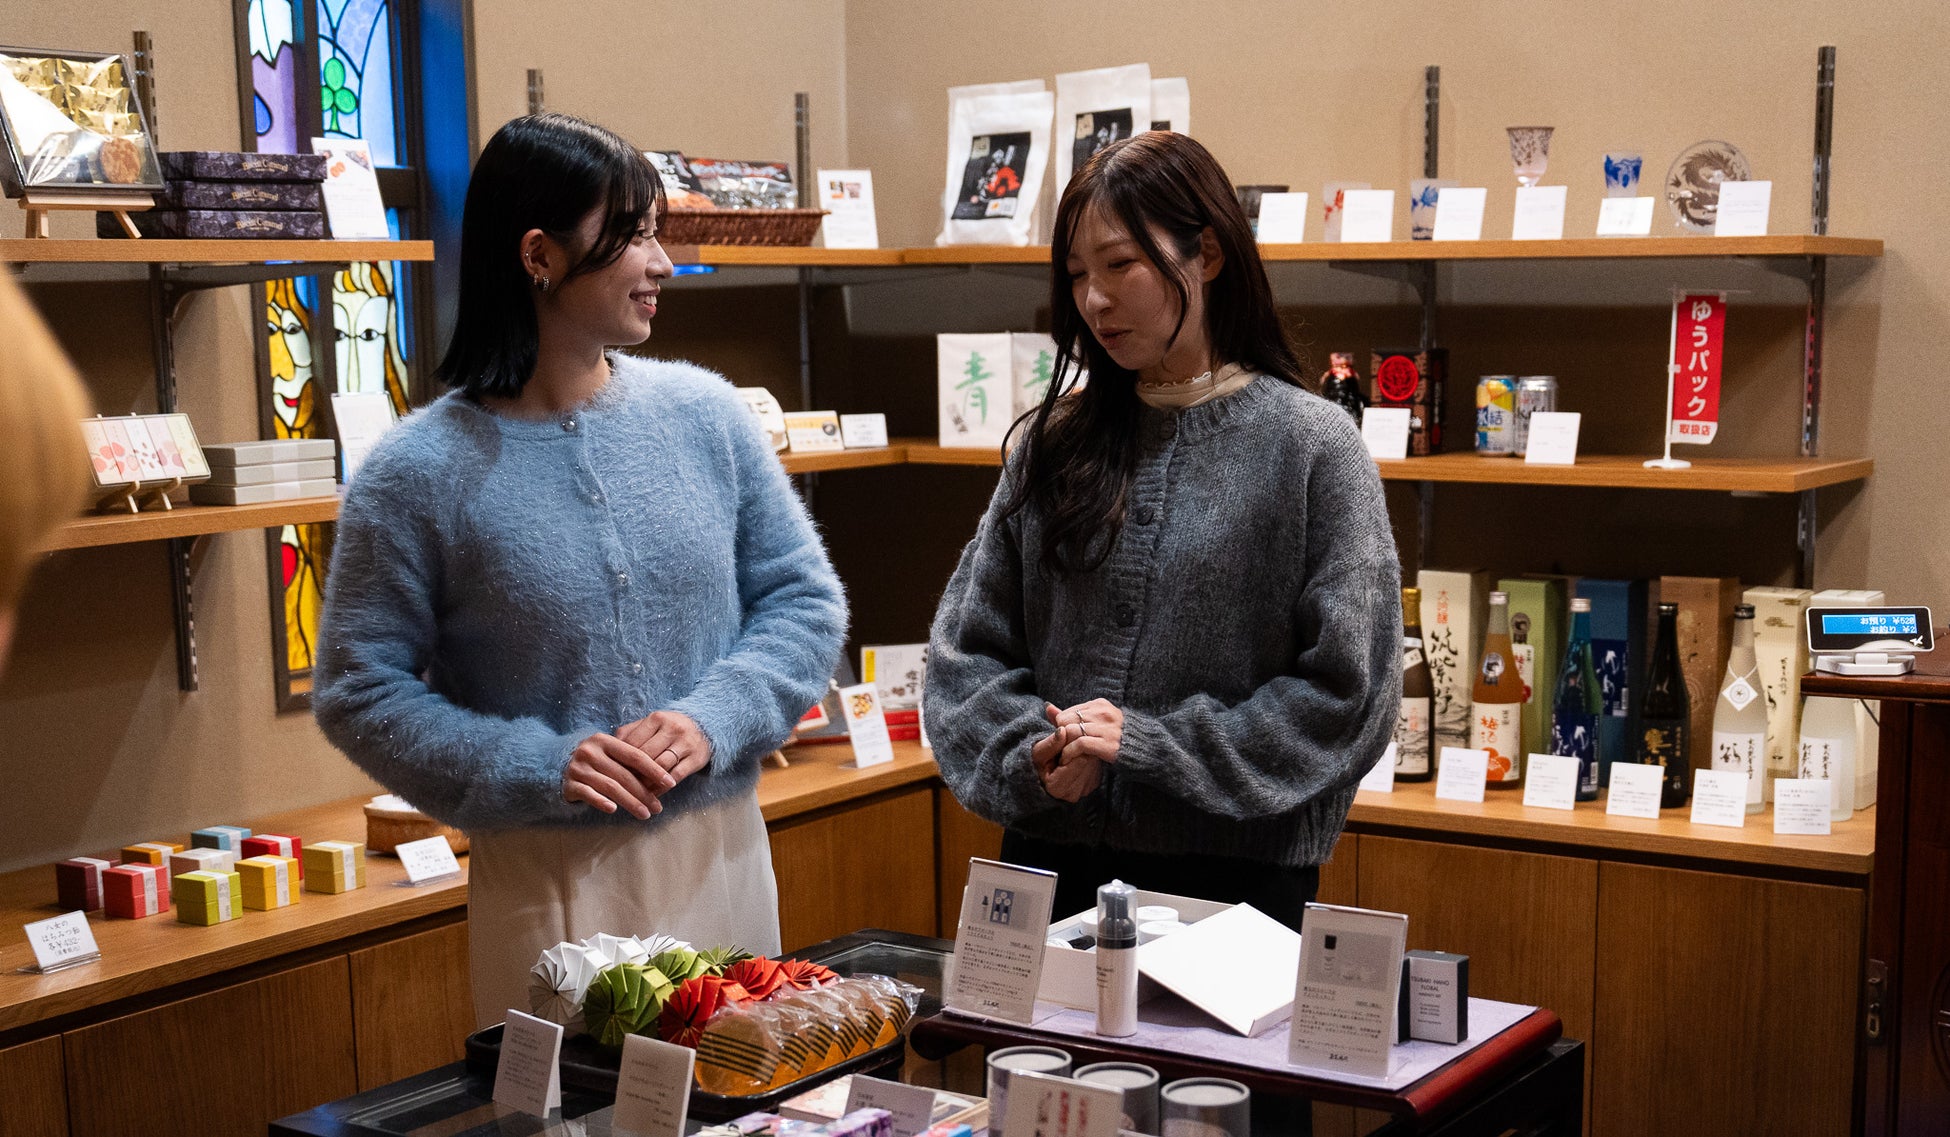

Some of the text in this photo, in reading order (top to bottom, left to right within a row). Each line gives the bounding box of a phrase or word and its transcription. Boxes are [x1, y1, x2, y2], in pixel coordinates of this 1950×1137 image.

[954, 350, 996, 425] 青
[1687, 300, 1712, 417] ゆうパック
[1679, 424, 1711, 436] 取扱店
